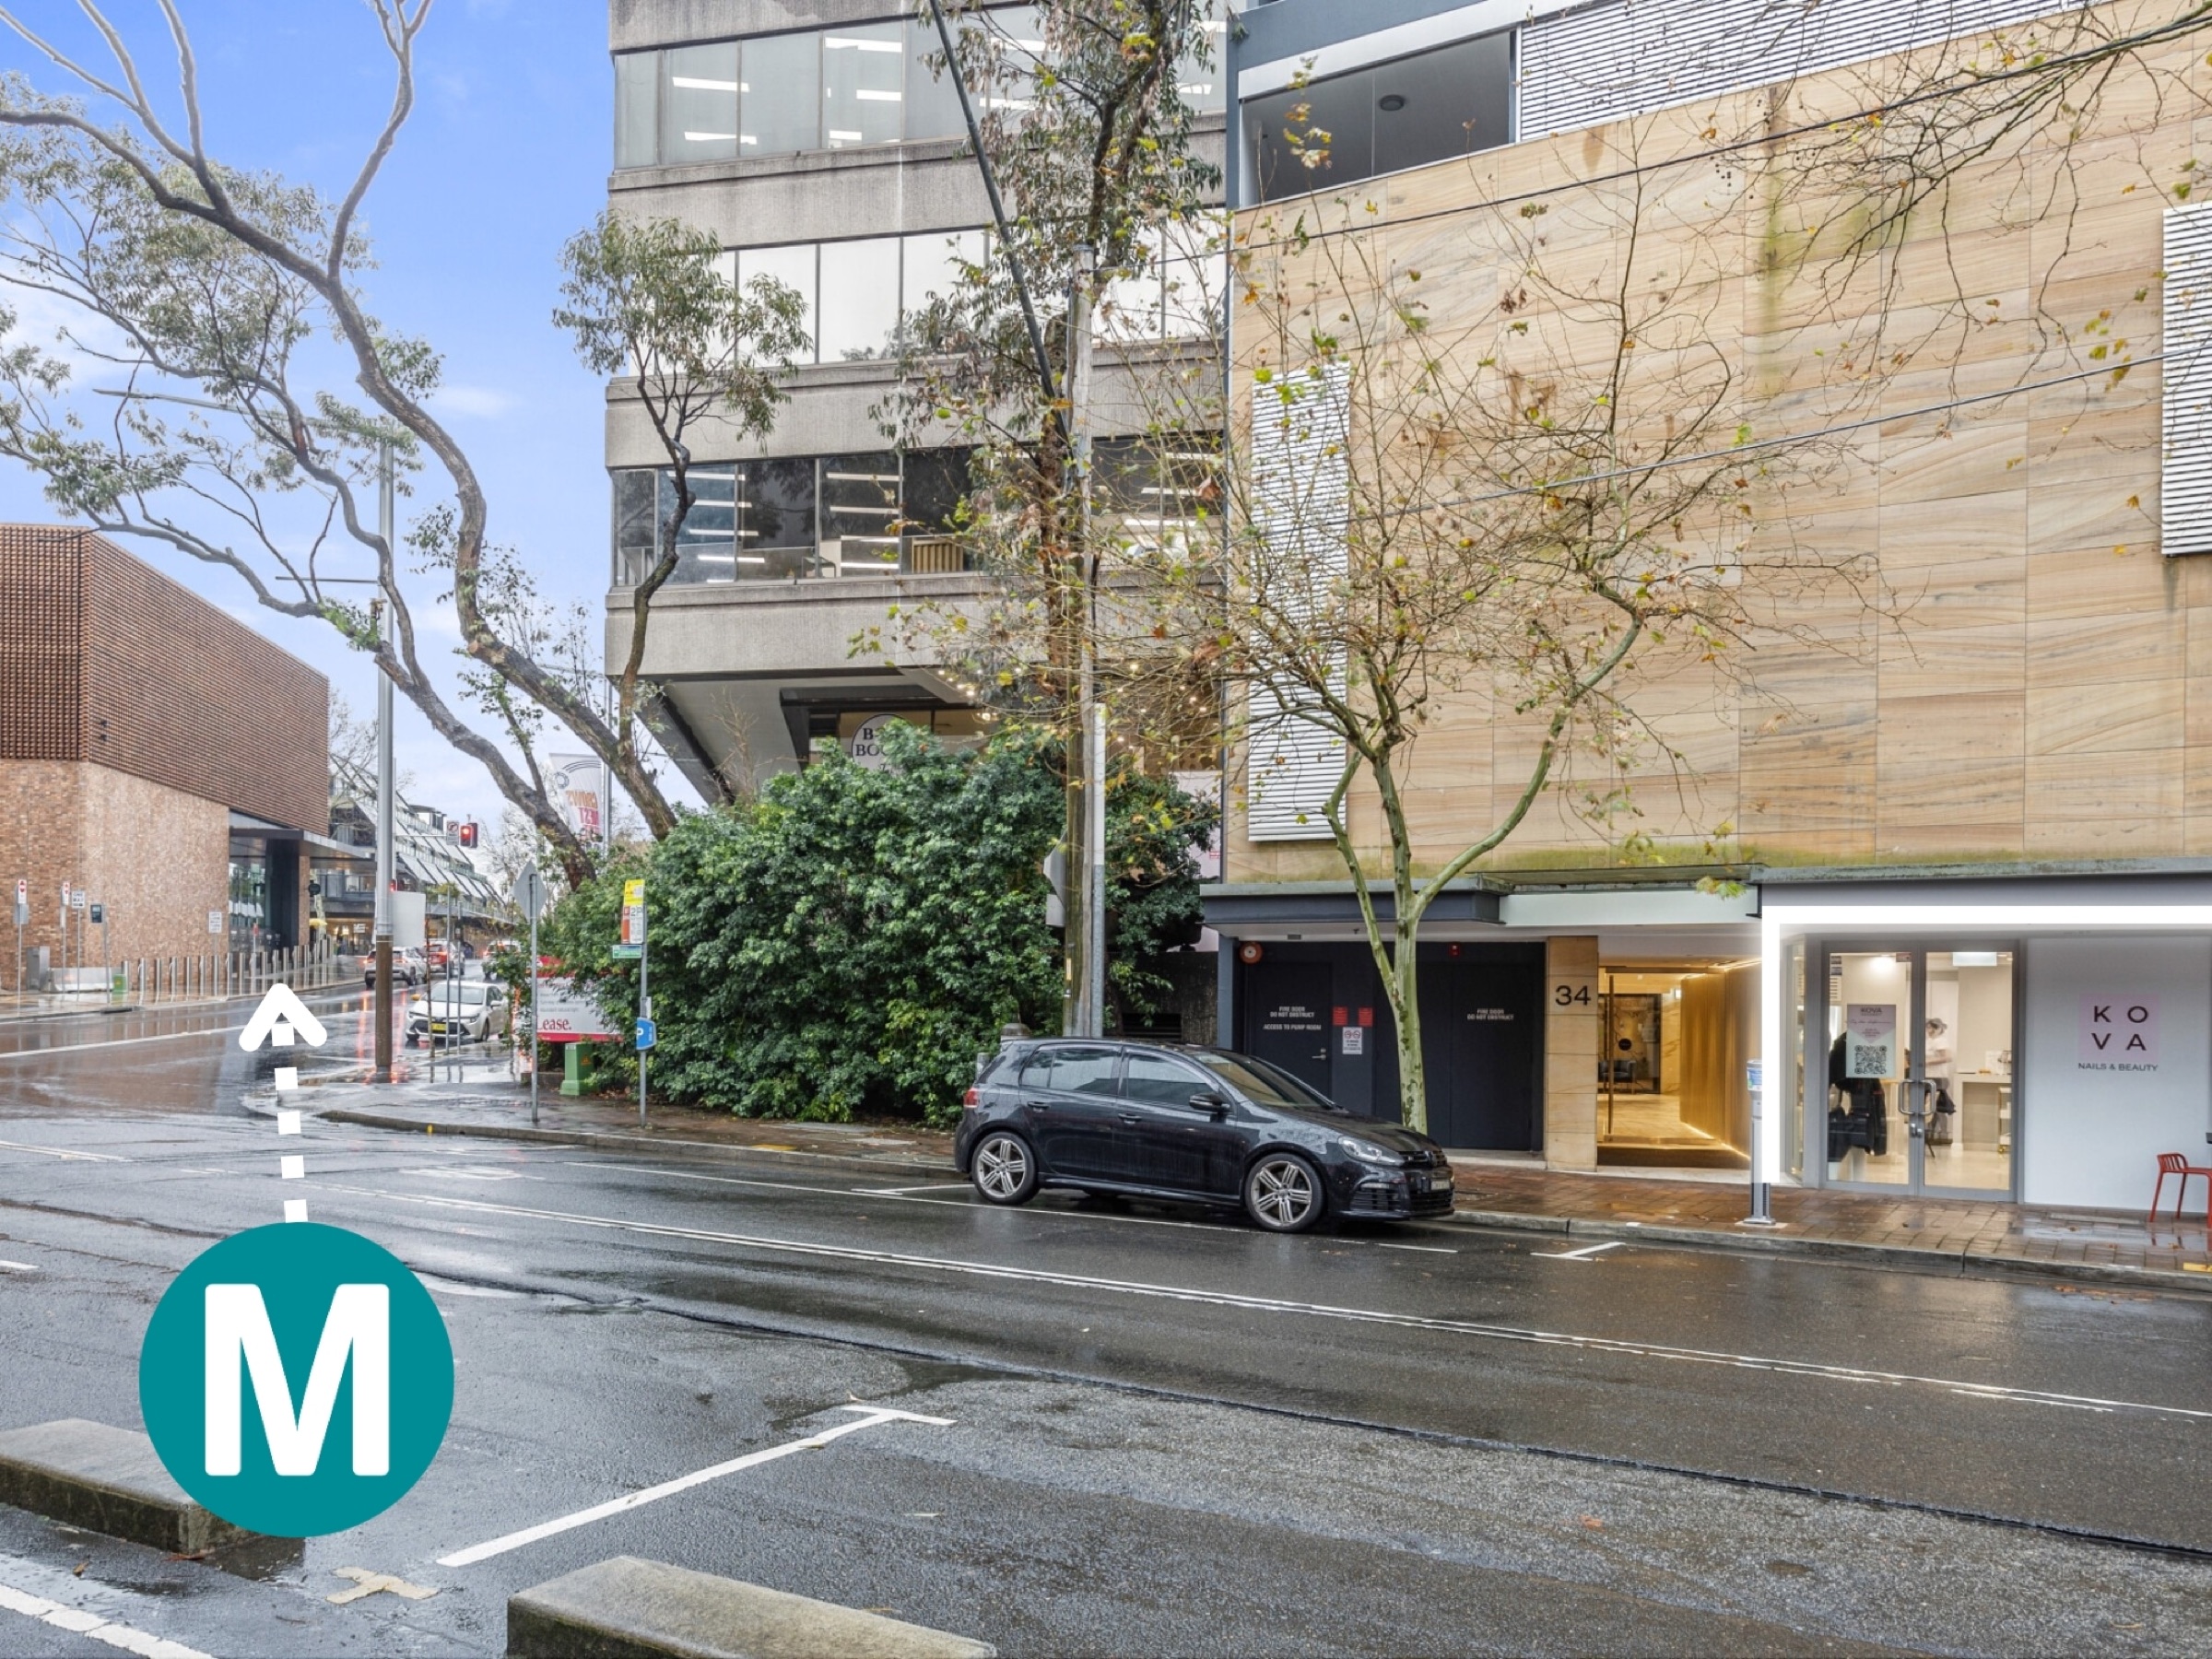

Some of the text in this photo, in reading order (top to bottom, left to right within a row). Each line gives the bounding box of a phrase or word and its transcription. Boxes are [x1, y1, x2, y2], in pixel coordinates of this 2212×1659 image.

[1555, 984, 1592, 1006] 34
[536, 1018, 571, 1030] ease.
[2077, 1062, 2107, 1070] NAILS
[2118, 1063, 2159, 1072] BEAUTY
